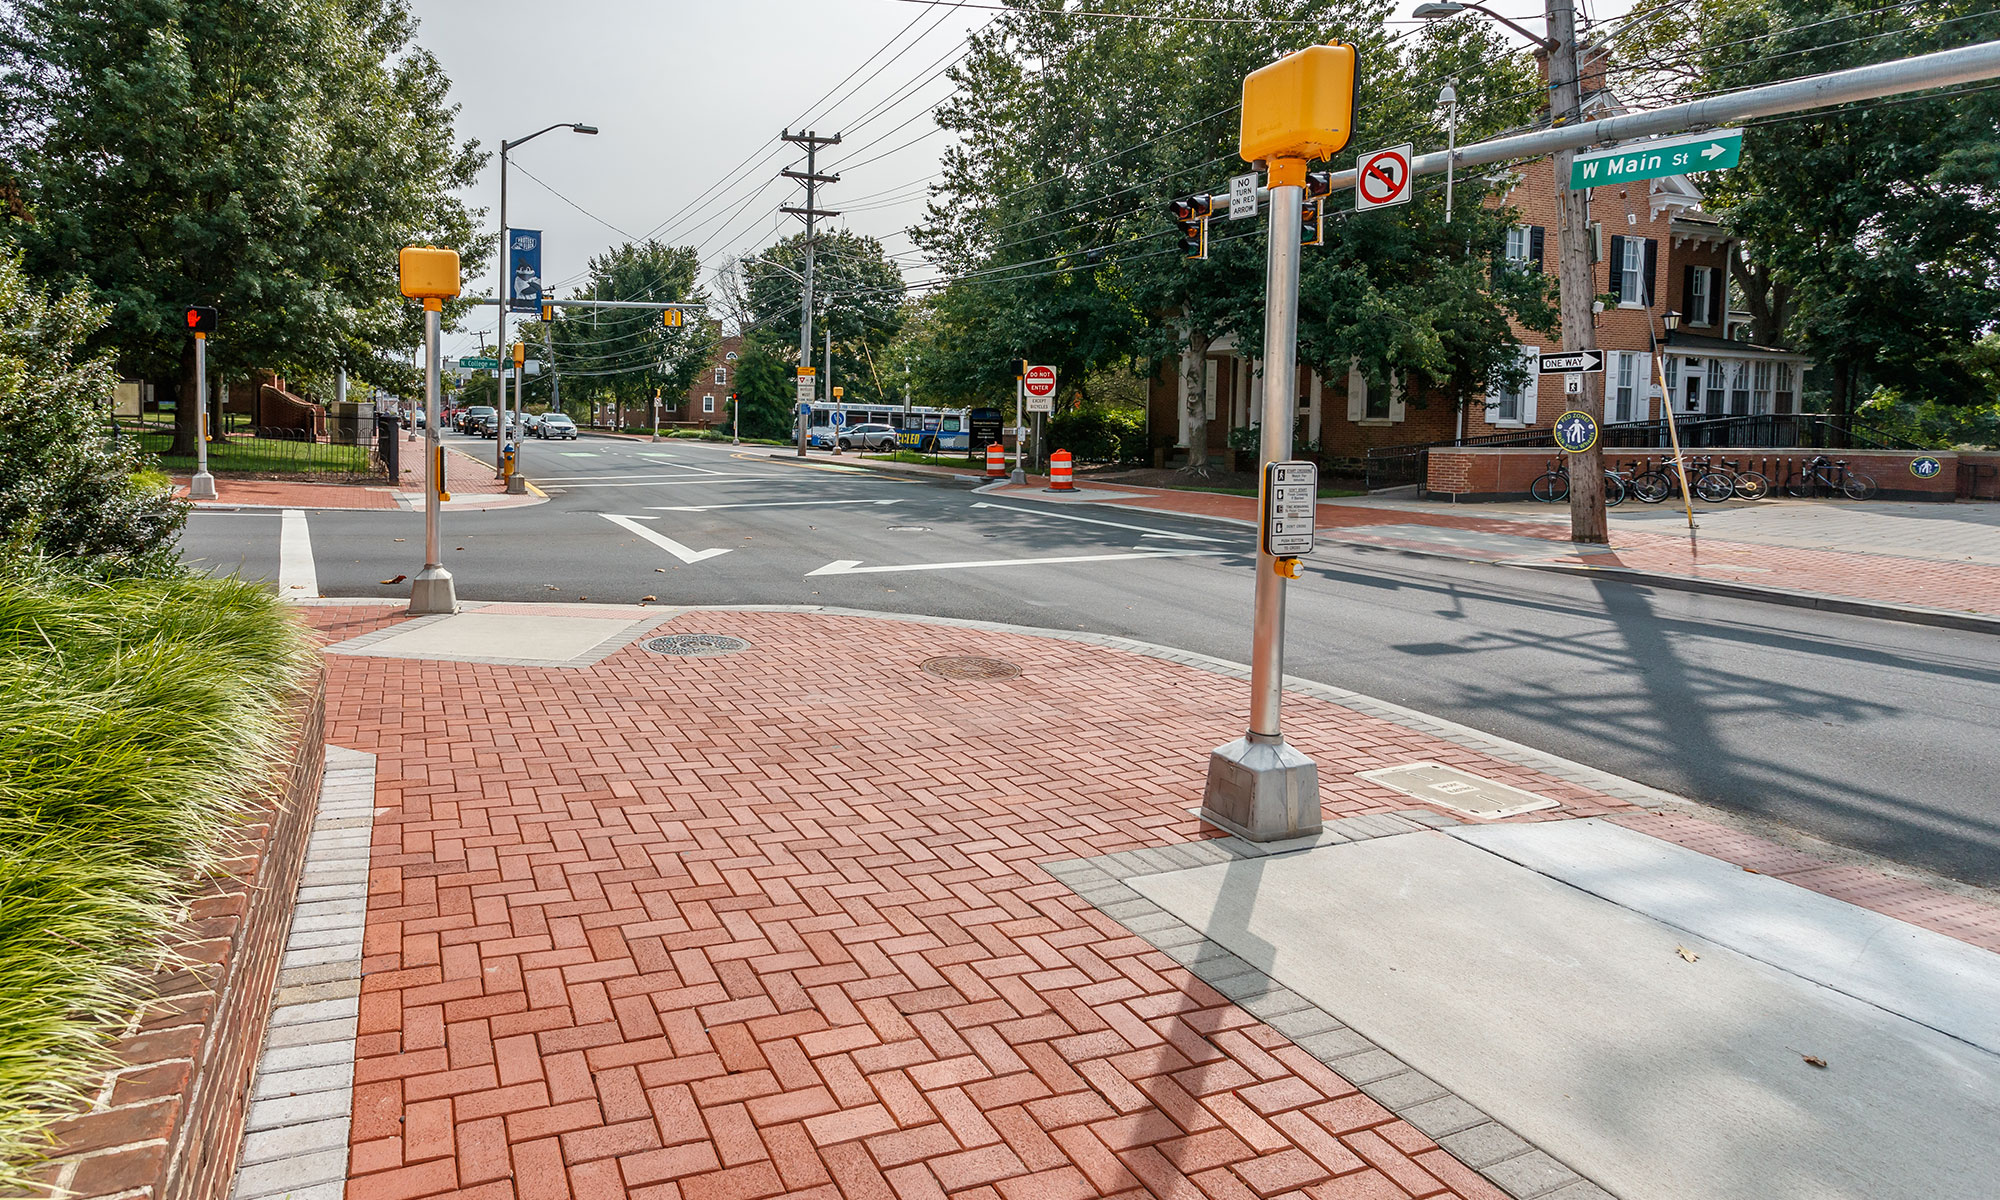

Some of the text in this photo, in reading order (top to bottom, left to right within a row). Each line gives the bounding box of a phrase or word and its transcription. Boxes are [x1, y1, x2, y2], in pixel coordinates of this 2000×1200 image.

[1583, 152, 1688, 179] W Main St
[1238, 178, 1250, 187] NO
[1236, 188, 1251, 196] TURN
[1243, 195, 1254, 203] RED
[1234, 205, 1253, 214] ARROW
[468, 360, 488, 368] College
[1565, 358, 1583, 366] WAY
[1561, 415, 1571, 423] PED
